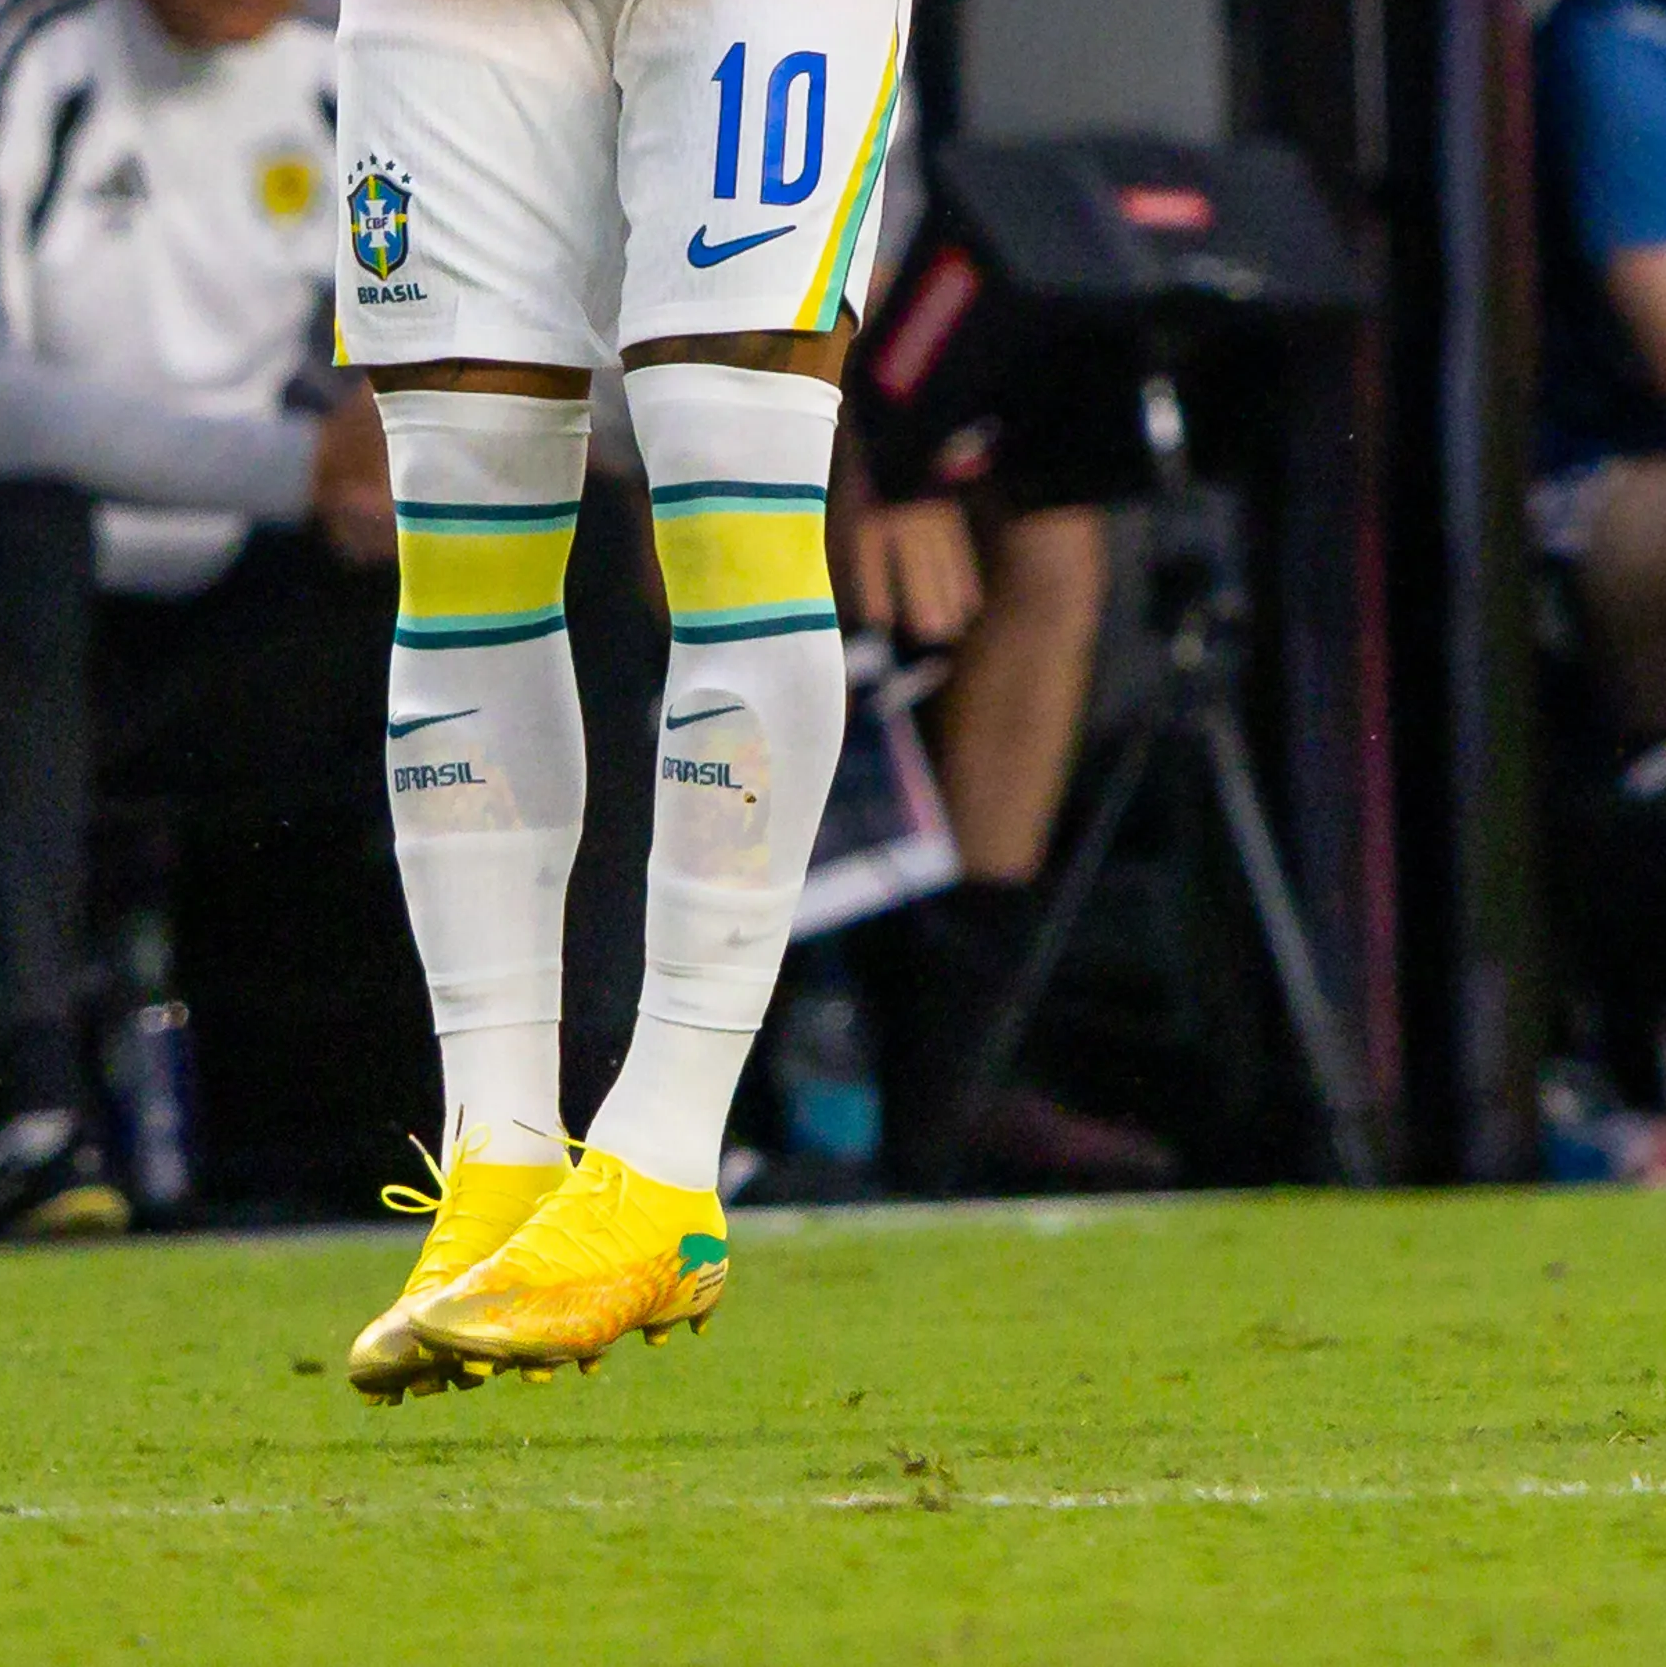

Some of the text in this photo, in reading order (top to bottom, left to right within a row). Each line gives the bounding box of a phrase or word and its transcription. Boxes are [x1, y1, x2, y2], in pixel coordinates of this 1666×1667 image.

[711, 42, 827, 206] 10
[365, 217, 388, 230] CBF
[357, 283, 427, 305] BRASIL
[394, 762, 486, 793] BRASIL
[662, 756, 743, 789] BRASIL
